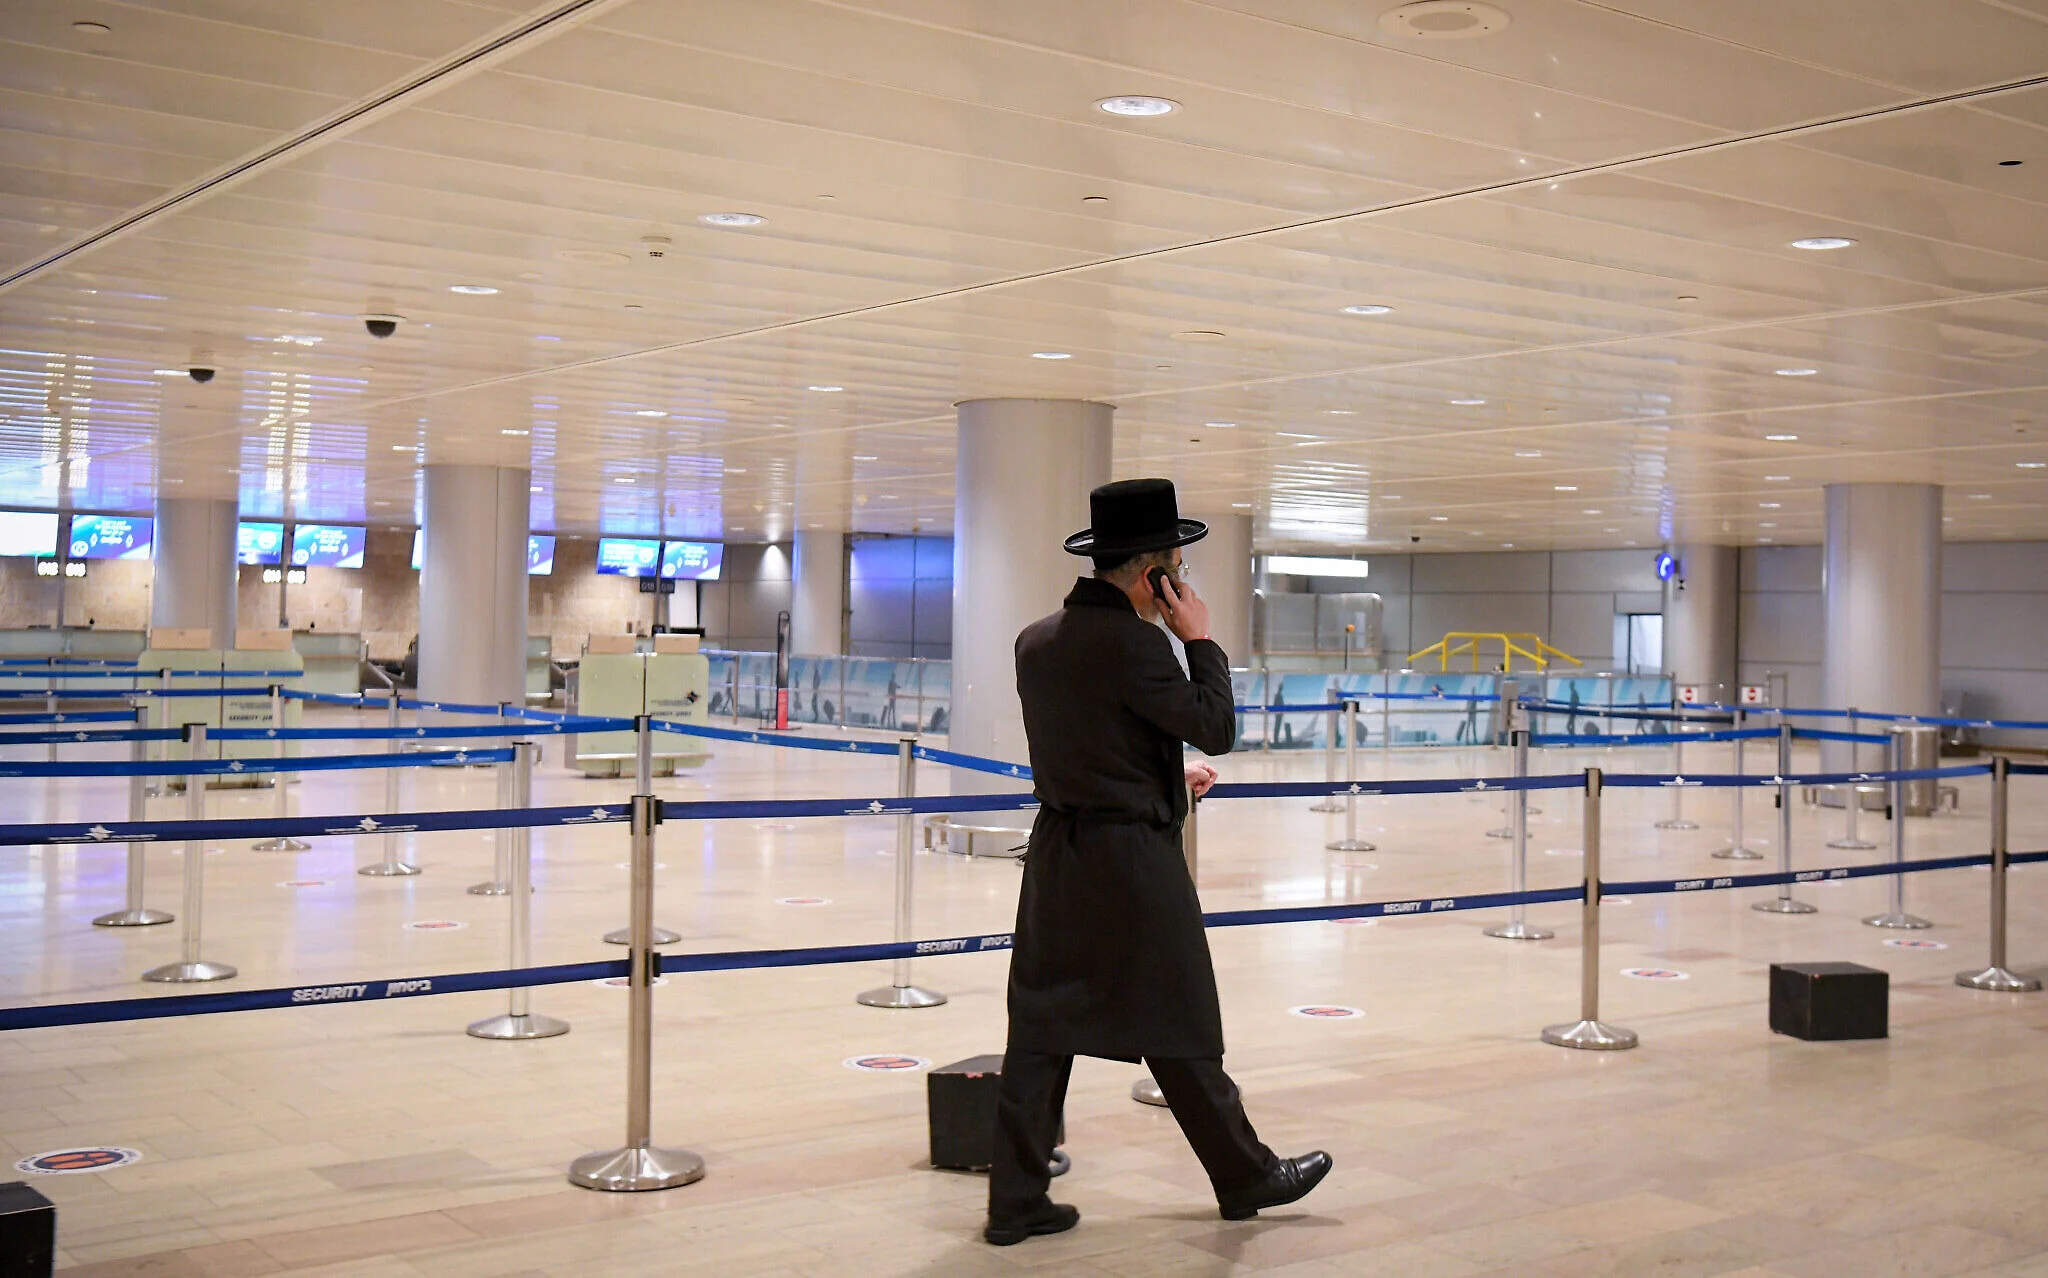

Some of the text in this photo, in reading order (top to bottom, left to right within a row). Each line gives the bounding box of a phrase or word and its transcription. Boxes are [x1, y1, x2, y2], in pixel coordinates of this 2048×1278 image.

[1383, 902, 1421, 913] SECURITY
[916, 940, 967, 953] SECURITY
[292, 985, 367, 1001] SECURITY
